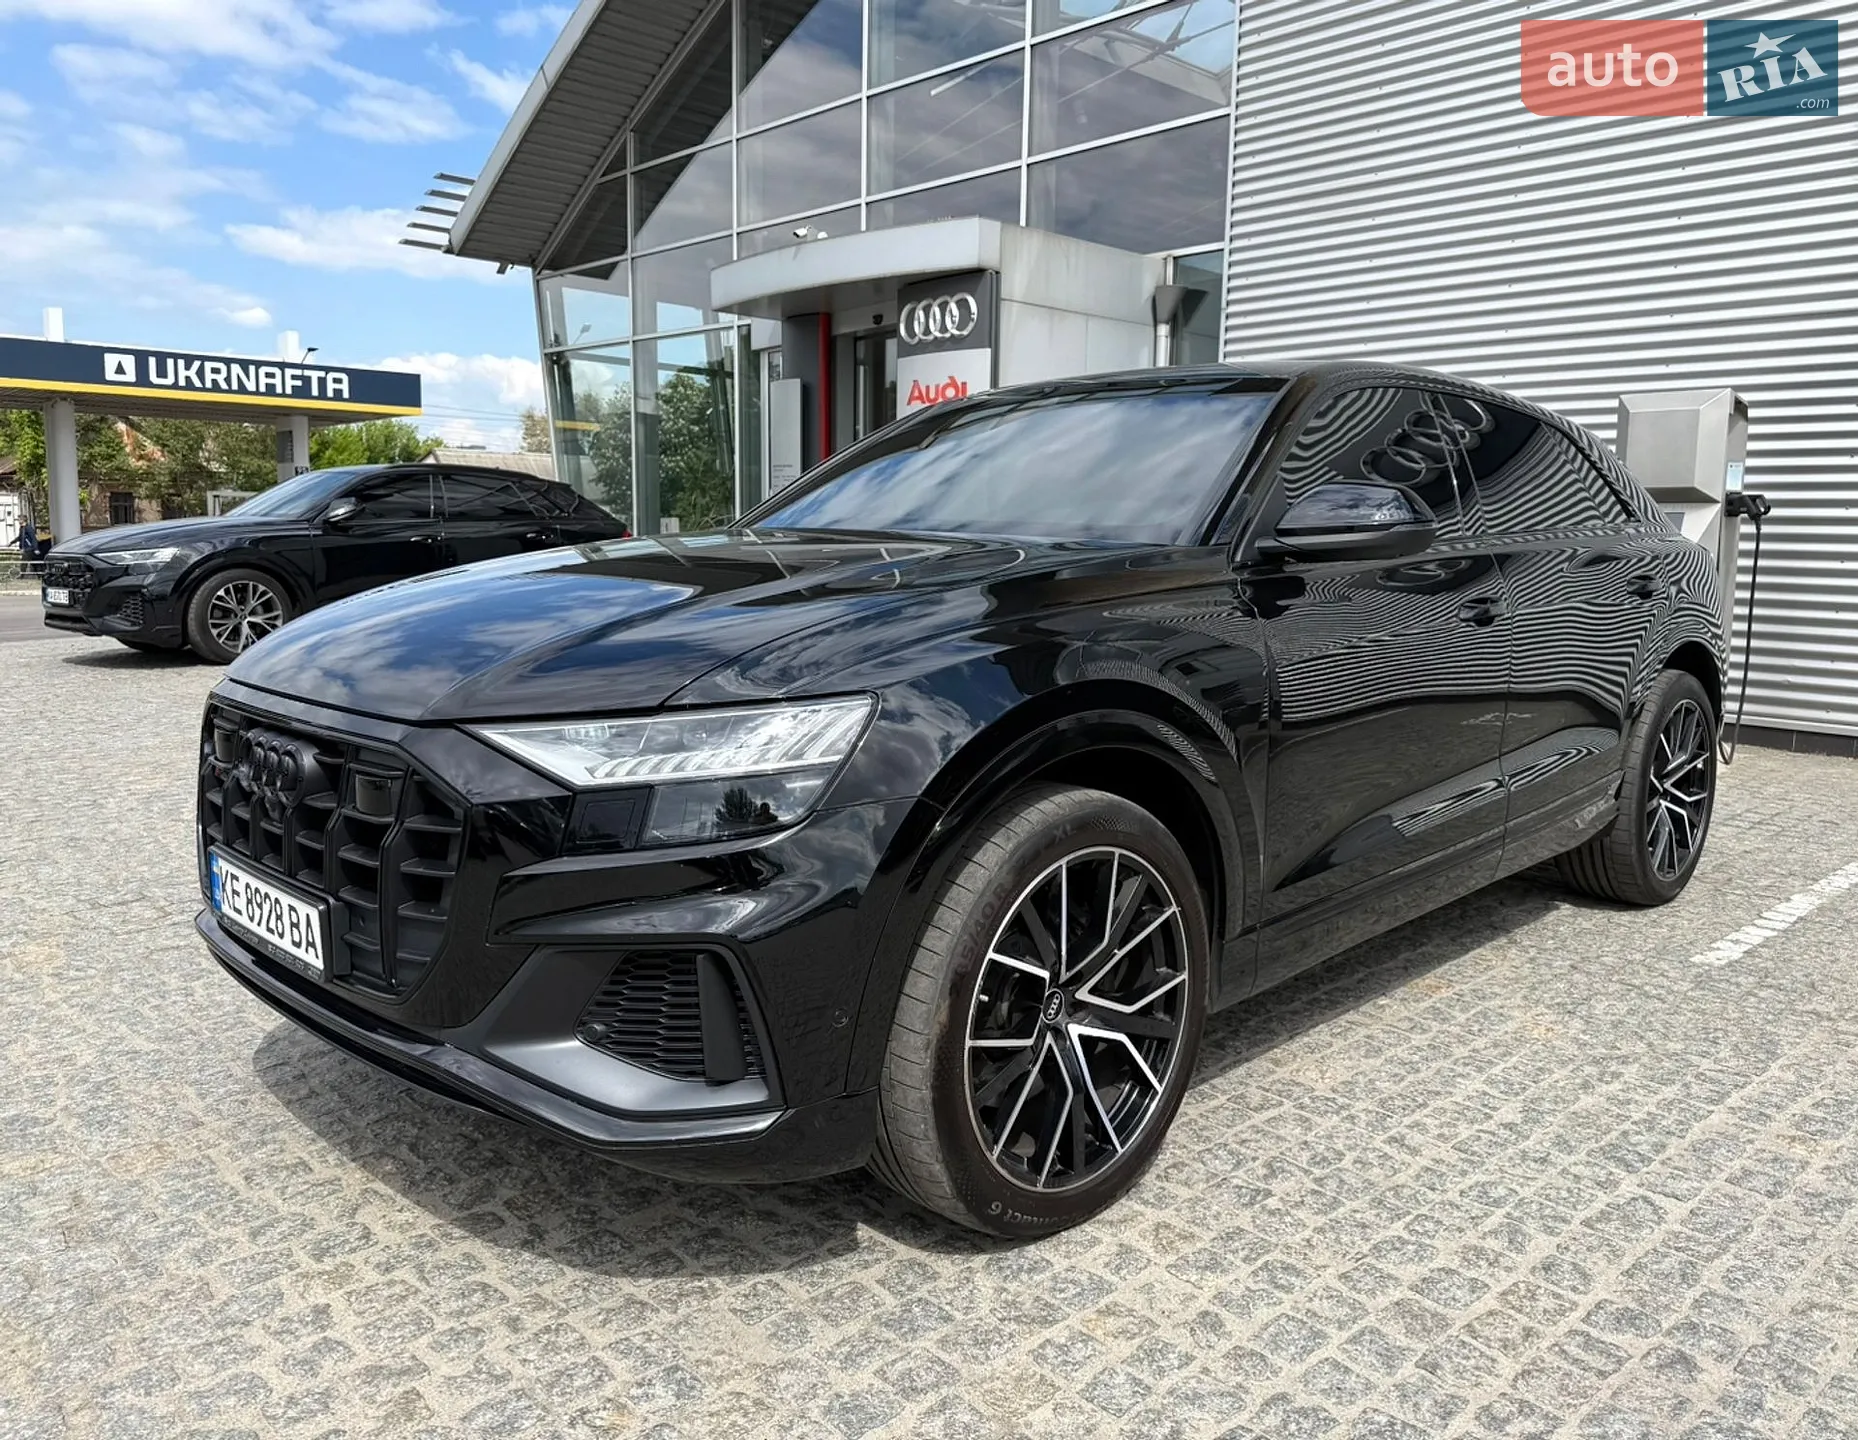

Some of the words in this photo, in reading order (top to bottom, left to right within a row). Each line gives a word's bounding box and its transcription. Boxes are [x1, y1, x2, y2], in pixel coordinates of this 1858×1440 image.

[148, 355, 350, 400] UKRNAFTA
[906, 375, 970, 406] Audi
[220, 865, 243, 916] KE
[245, 881, 285, 940] 8928
[288, 903, 319, 960] BA
